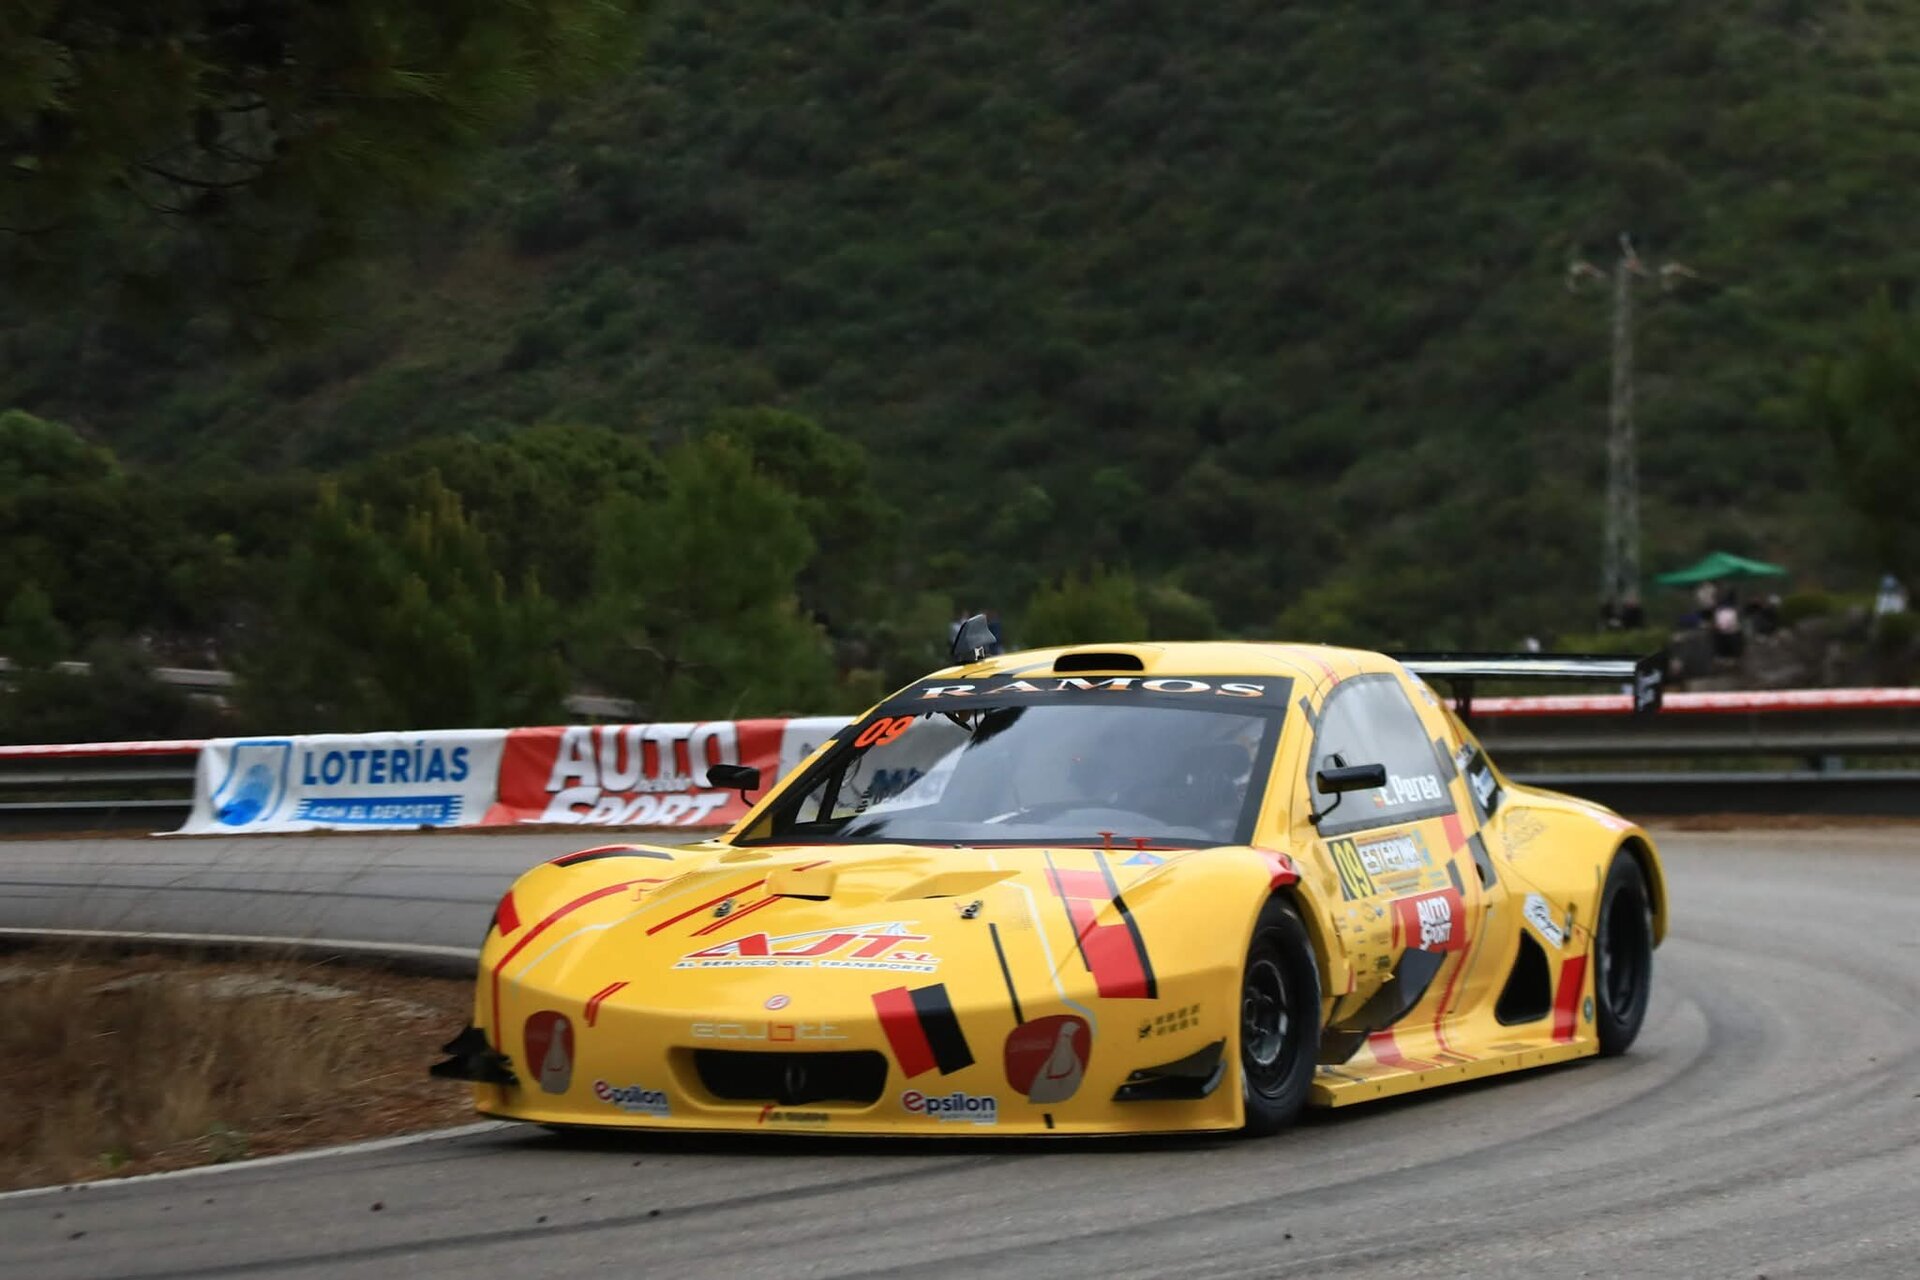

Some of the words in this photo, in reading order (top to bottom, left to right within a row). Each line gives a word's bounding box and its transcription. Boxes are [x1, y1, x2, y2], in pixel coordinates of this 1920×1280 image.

[920, 677, 1266, 699] RAMOS
[854, 715, 915, 748] 09
[302, 740, 469, 785] LOTERÍAS
[545, 722, 738, 791] AUTO
[369, 803, 444, 819] DEPORTE
[1333, 839, 1374, 900] 09
[1416, 896, 1451, 923] AUTO
[685, 934, 927, 957] AJT
[1420, 922, 1452, 951] SPORT
[820, 961, 935, 971] TRANSPORTE
[594, 1079, 669, 1107] epsilon
[902, 1091, 996, 1115] epsilon
